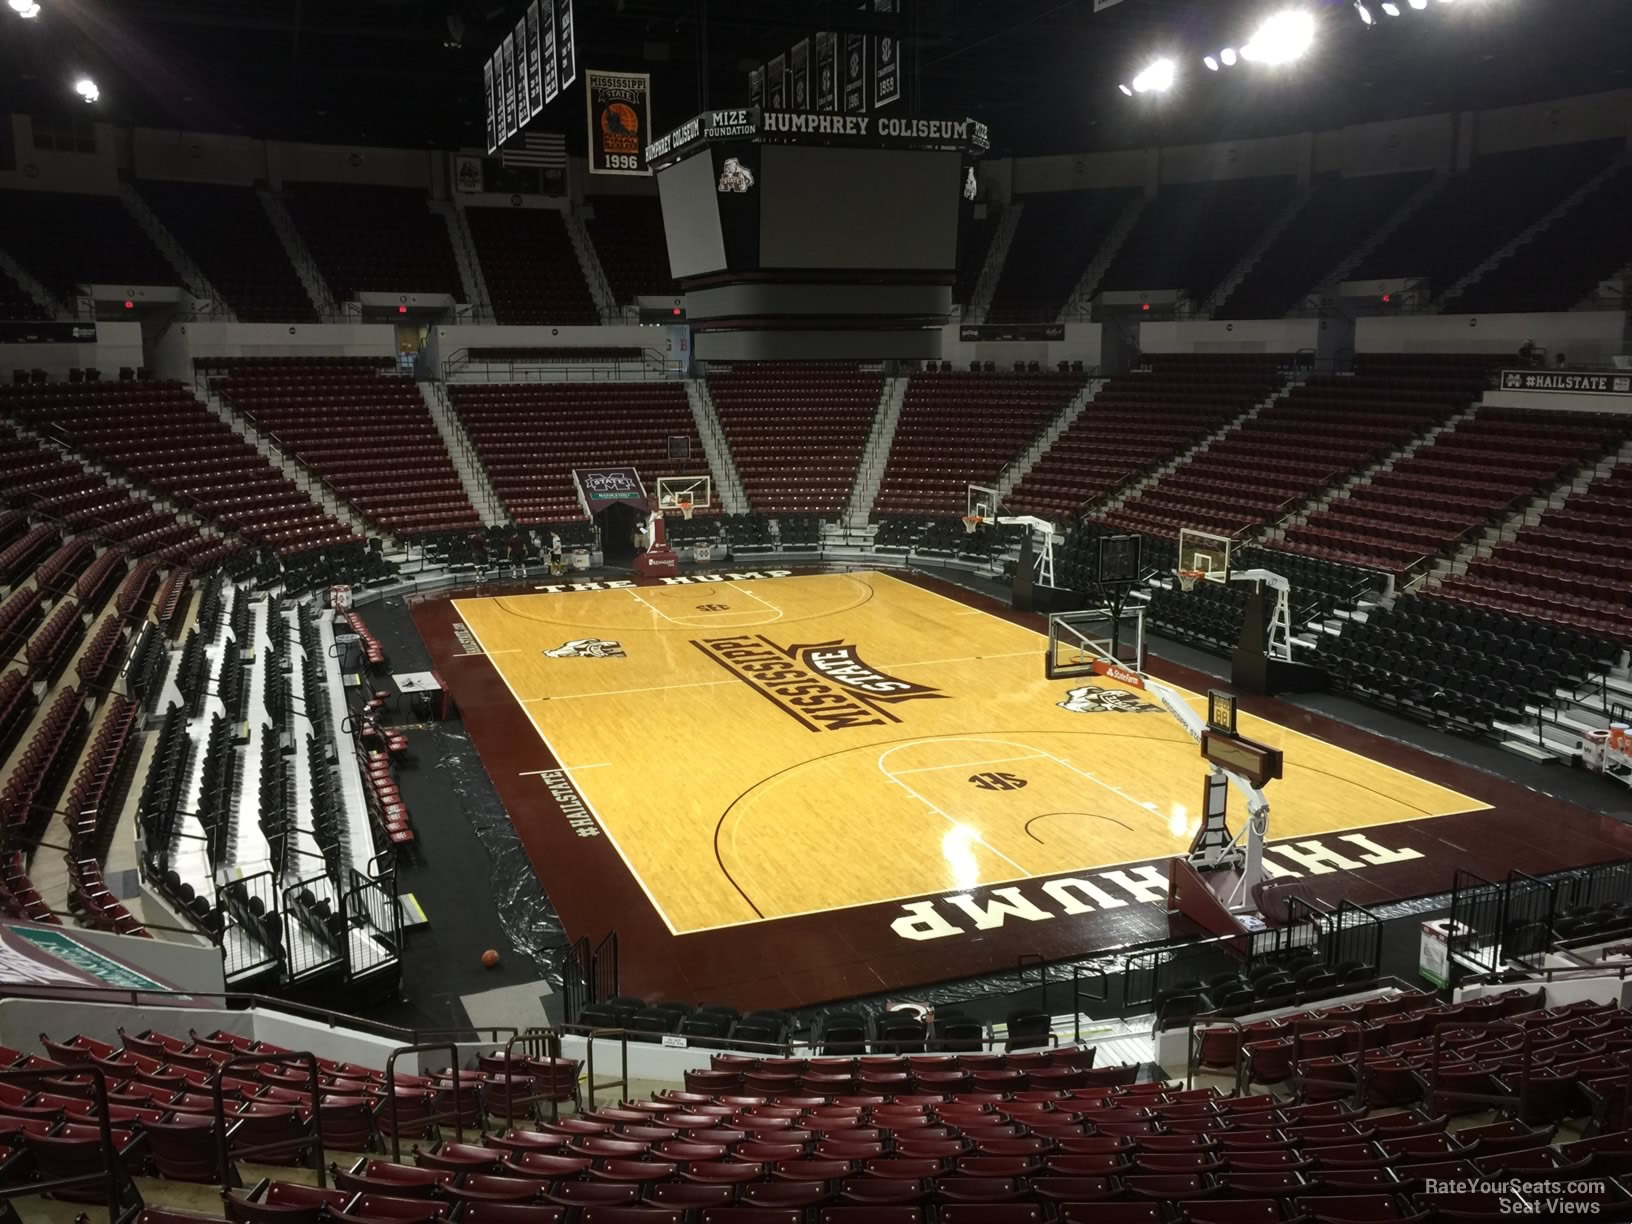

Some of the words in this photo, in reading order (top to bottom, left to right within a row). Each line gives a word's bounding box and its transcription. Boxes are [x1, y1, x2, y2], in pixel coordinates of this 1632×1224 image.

[590, 76, 646, 89] MISSISSIPPI
[605, 90, 632, 100] STATE
[712, 110, 747, 126] MIZE
[764, 112, 869, 135] HUMPHREY
[878, 118, 968, 139] COLISEUM
[645, 134, 672, 163] HUMPHREY
[672, 118, 699, 149] COLISEUM
[704, 125, 756, 138] FOUNDATION
[605, 154, 637, 169] 1996
[1525, 375, 1608, 390] #HAILSTATE
[594, 478, 626, 486] STATE
[534, 580, 637, 593] THE
[659, 569, 793, 585] HUMP
[811, 649, 912, 692] STATE
[702, 635, 888, 731] MISSISSIPPI
[1161, 696, 1189, 730] MISSISSIPPI
[968, 772, 1028, 790] SEC
[540, 771, 600, 837] #HAILSTATE
[890, 865, 1170, 941] HUMP
